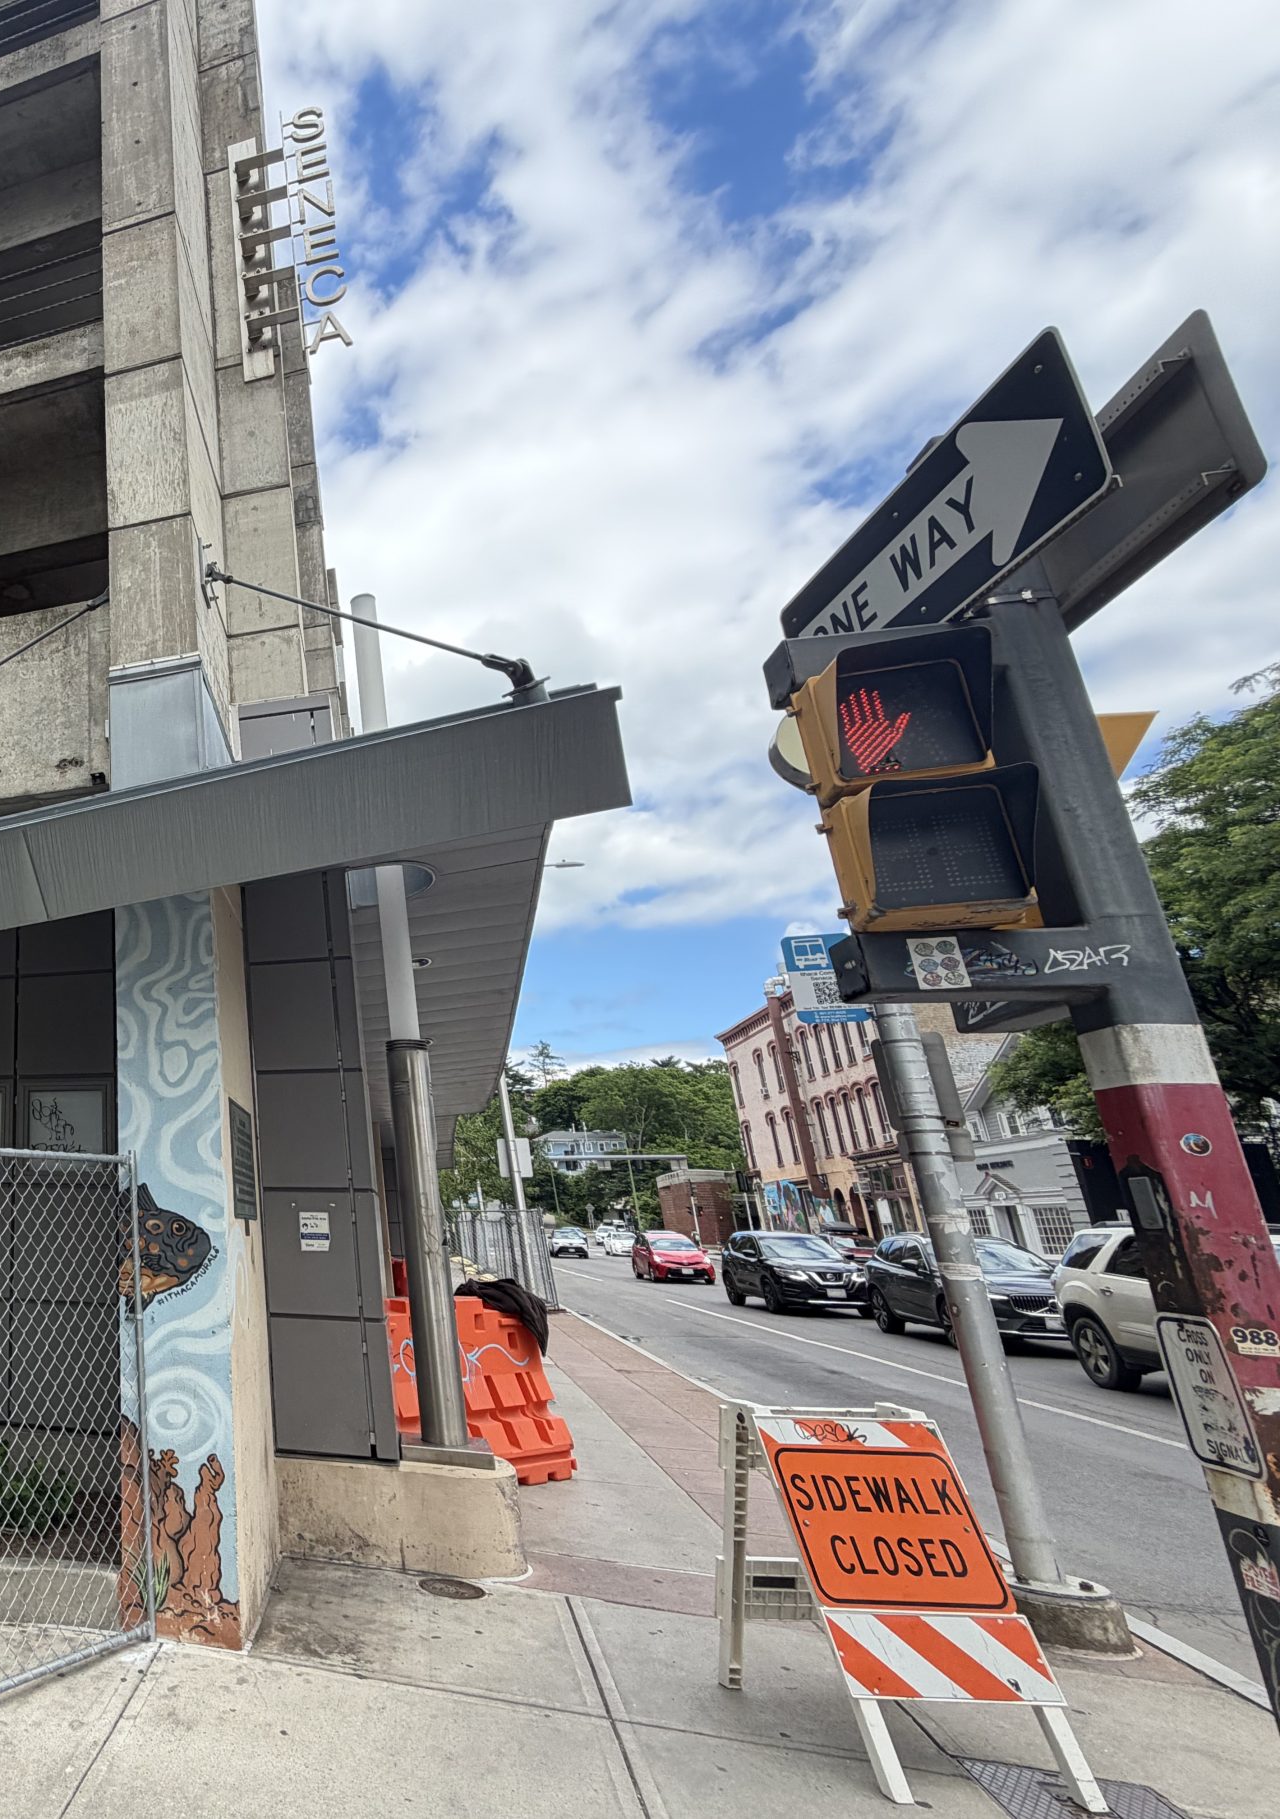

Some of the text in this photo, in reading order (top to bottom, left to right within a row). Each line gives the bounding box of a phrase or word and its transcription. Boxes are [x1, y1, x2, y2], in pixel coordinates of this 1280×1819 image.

[290, 106, 353, 355] SENECA
[889, 475, 976, 593] WAY
[157, 1245, 220, 1306] #ITHACAMURALS
[1177, 1328, 1209, 1347] CROSS
[1232, 1328, 1279, 1347] 988
[1185, 1348, 1213, 1366] ONLY
[1199, 1368, 1216, 1385] ON
[1206, 1438, 1250, 1465] SIGNAL
[790, 1473, 963, 1516] SIDEWALK
[830, 1534, 968, 1578] CLOSED
